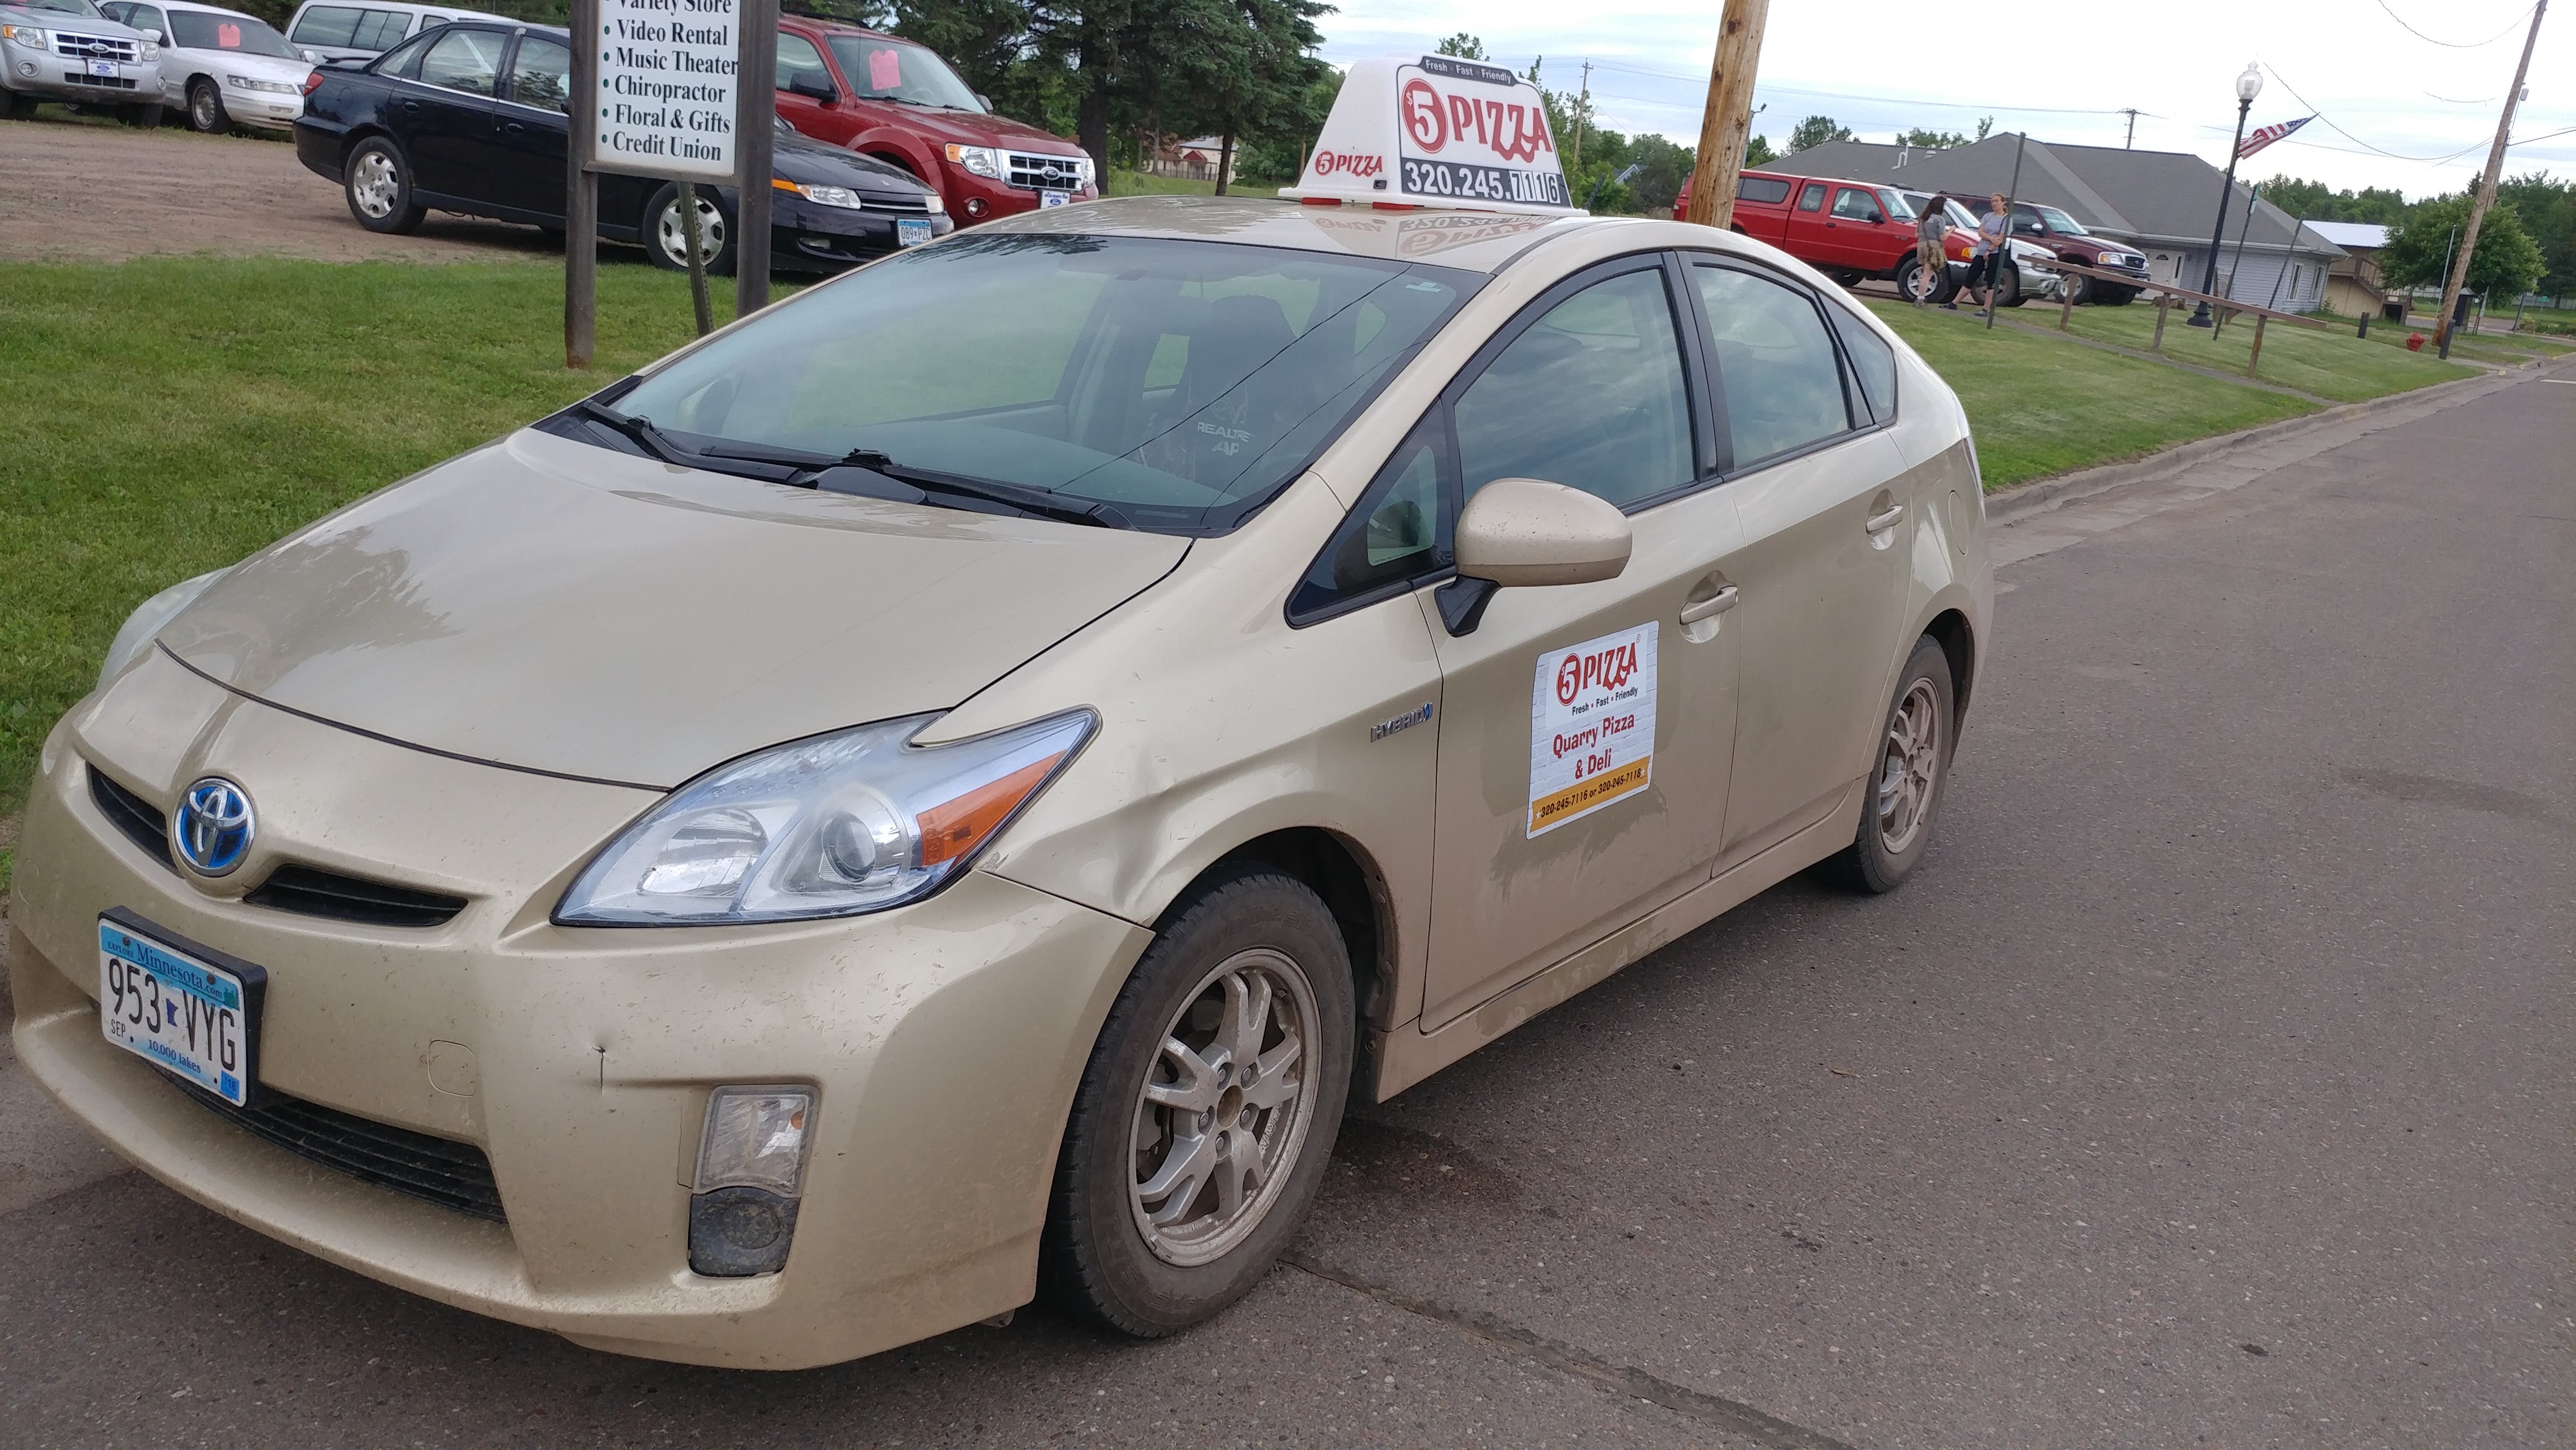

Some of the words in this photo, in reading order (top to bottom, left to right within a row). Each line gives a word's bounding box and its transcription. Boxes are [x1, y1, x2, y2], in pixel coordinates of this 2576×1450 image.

[684, 0, 732, 13] Store
[616, 19, 666, 42] Video
[670, 22, 728, 46] Rental
[615, 46, 668, 70] Music
[672, 50, 739, 75] Theater
[1425, 59, 1448, 73] Fresh
[1455, 64, 1474, 77] Fast
[1481, 68, 1512, 84] Friendly
[615, 74, 726, 103] Chiropractor
[614, 103, 666, 128] Floral
[670, 108, 684, 129] &
[689, 110, 731, 133] Gifts
[1447, 95, 1553, 164] PIZZA
[613, 131, 665, 155] Credit
[669, 136, 721, 161] Union
[1336, 154, 1383, 177] PIZZA
[1404, 162, 1561, 204] 320.245.7116
[901, 226, 914, 240] 089
[1582, 642, 1638, 691] PIZZA
[1571, 703, 1589, 717] Fresh
[1596, 697, 1609, 708] Fast
[1615, 686, 1638, 702] Friendly
[1370, 708, 1425, 743] HYBRID
[1553, 725, 1598, 759] Quarry
[1602, 713, 1635, 738] Pizza
[1575, 759, 1583, 780] &
[1587, 748, 1612, 775] Deli
[1540, 789, 1588, 818] 320-245-7116
[1589, 788, 1597, 798] or
[1598, 768, 1642, 795] 320-245-7118
[109, 958, 162, 1034] 953
[183, 989, 236, 1072] VYG
[111, 1018, 126, 1038] SEP
[148, 1039, 176, 1061] 10,000
[178, 1054, 201, 1074] lakes
